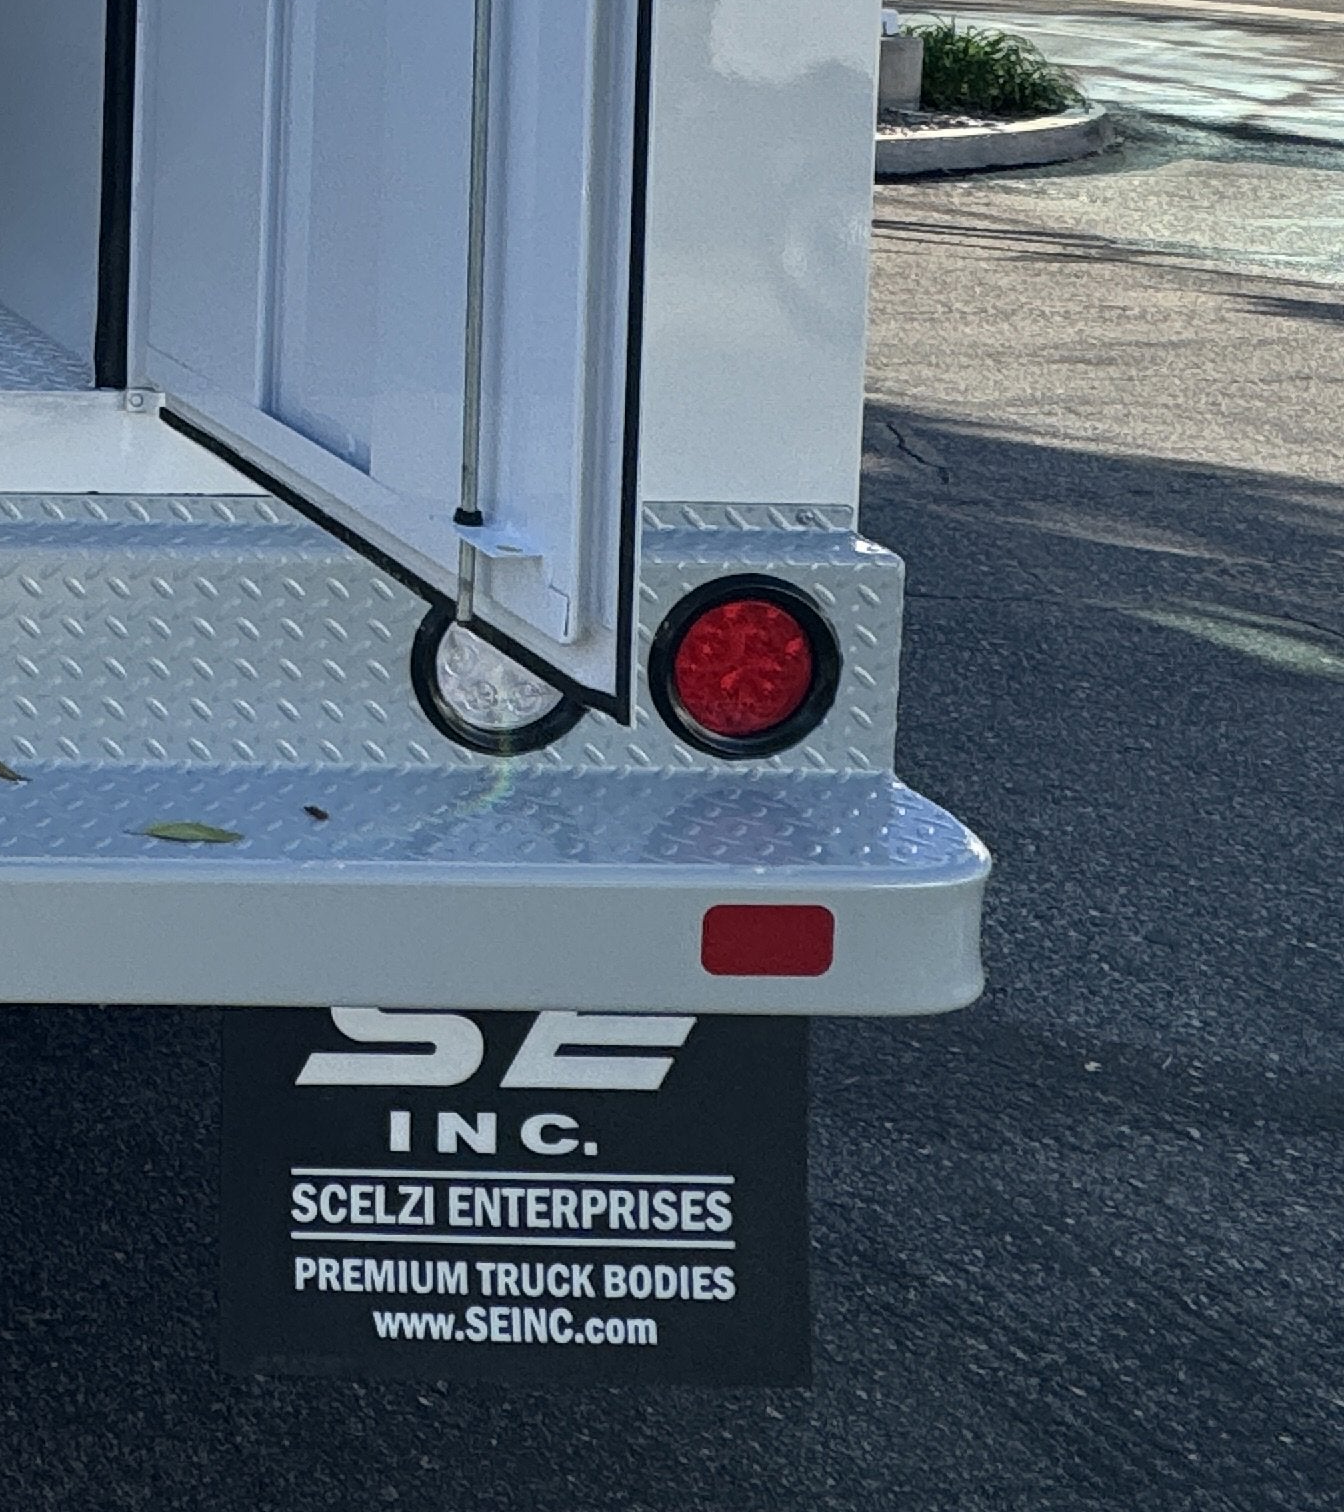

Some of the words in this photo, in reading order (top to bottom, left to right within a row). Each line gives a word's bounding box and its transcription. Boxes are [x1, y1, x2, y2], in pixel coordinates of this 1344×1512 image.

[295, 1006, 698, 1090] SE
[389, 1110, 598, 1156] INC.
[291, 1182, 434, 1225] SCELZI
[448, 1187, 733, 1232] ENTERPRISES
[294, 1257, 468, 1295] PREMIUM
[477, 1261, 596, 1298] TRUCK
[604, 1264, 735, 1301] BODIES
[373, 1306, 658, 1345] www.SEINC.com
